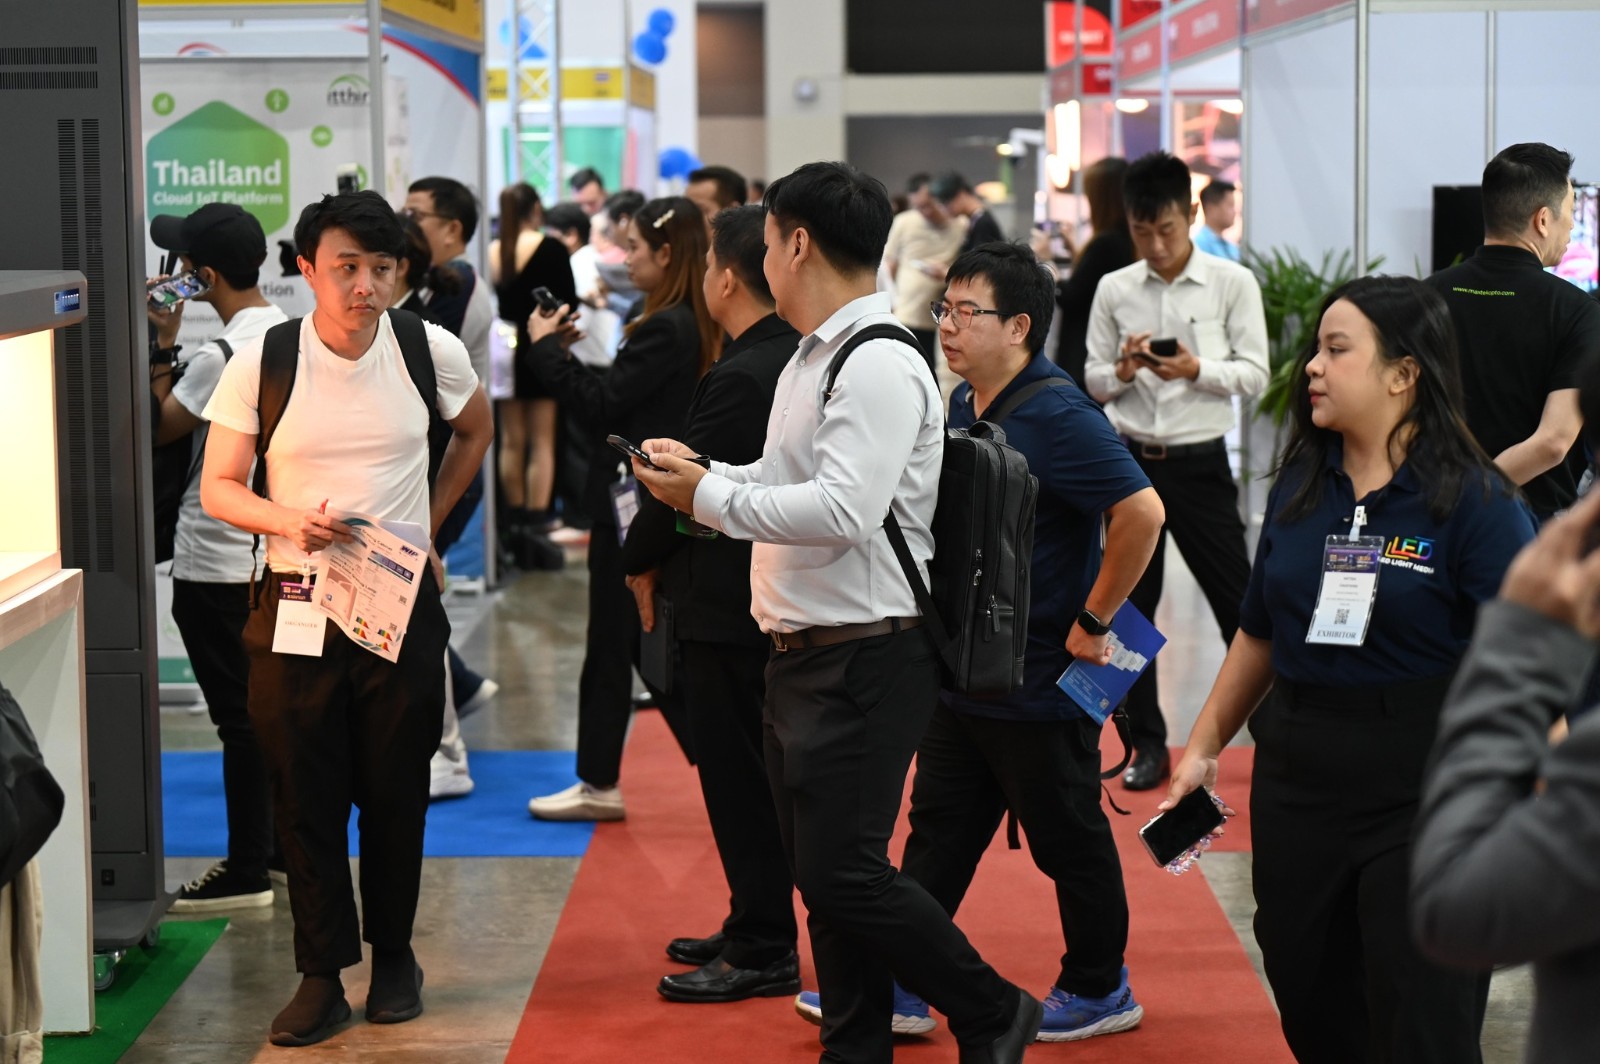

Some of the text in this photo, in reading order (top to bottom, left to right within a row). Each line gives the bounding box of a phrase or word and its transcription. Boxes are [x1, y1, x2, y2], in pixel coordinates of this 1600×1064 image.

[152, 158, 281, 187] Thailand
[153, 191, 284, 206] Cloud IoT Platform
[261, 282, 295, 297] tion
[1387, 536, 1434, 561] LED
[1377, 556, 1391, 564] LED
[1391, 558, 1413, 569] LIGHT
[1317, 629, 1357, 639] EXHIBITOR
